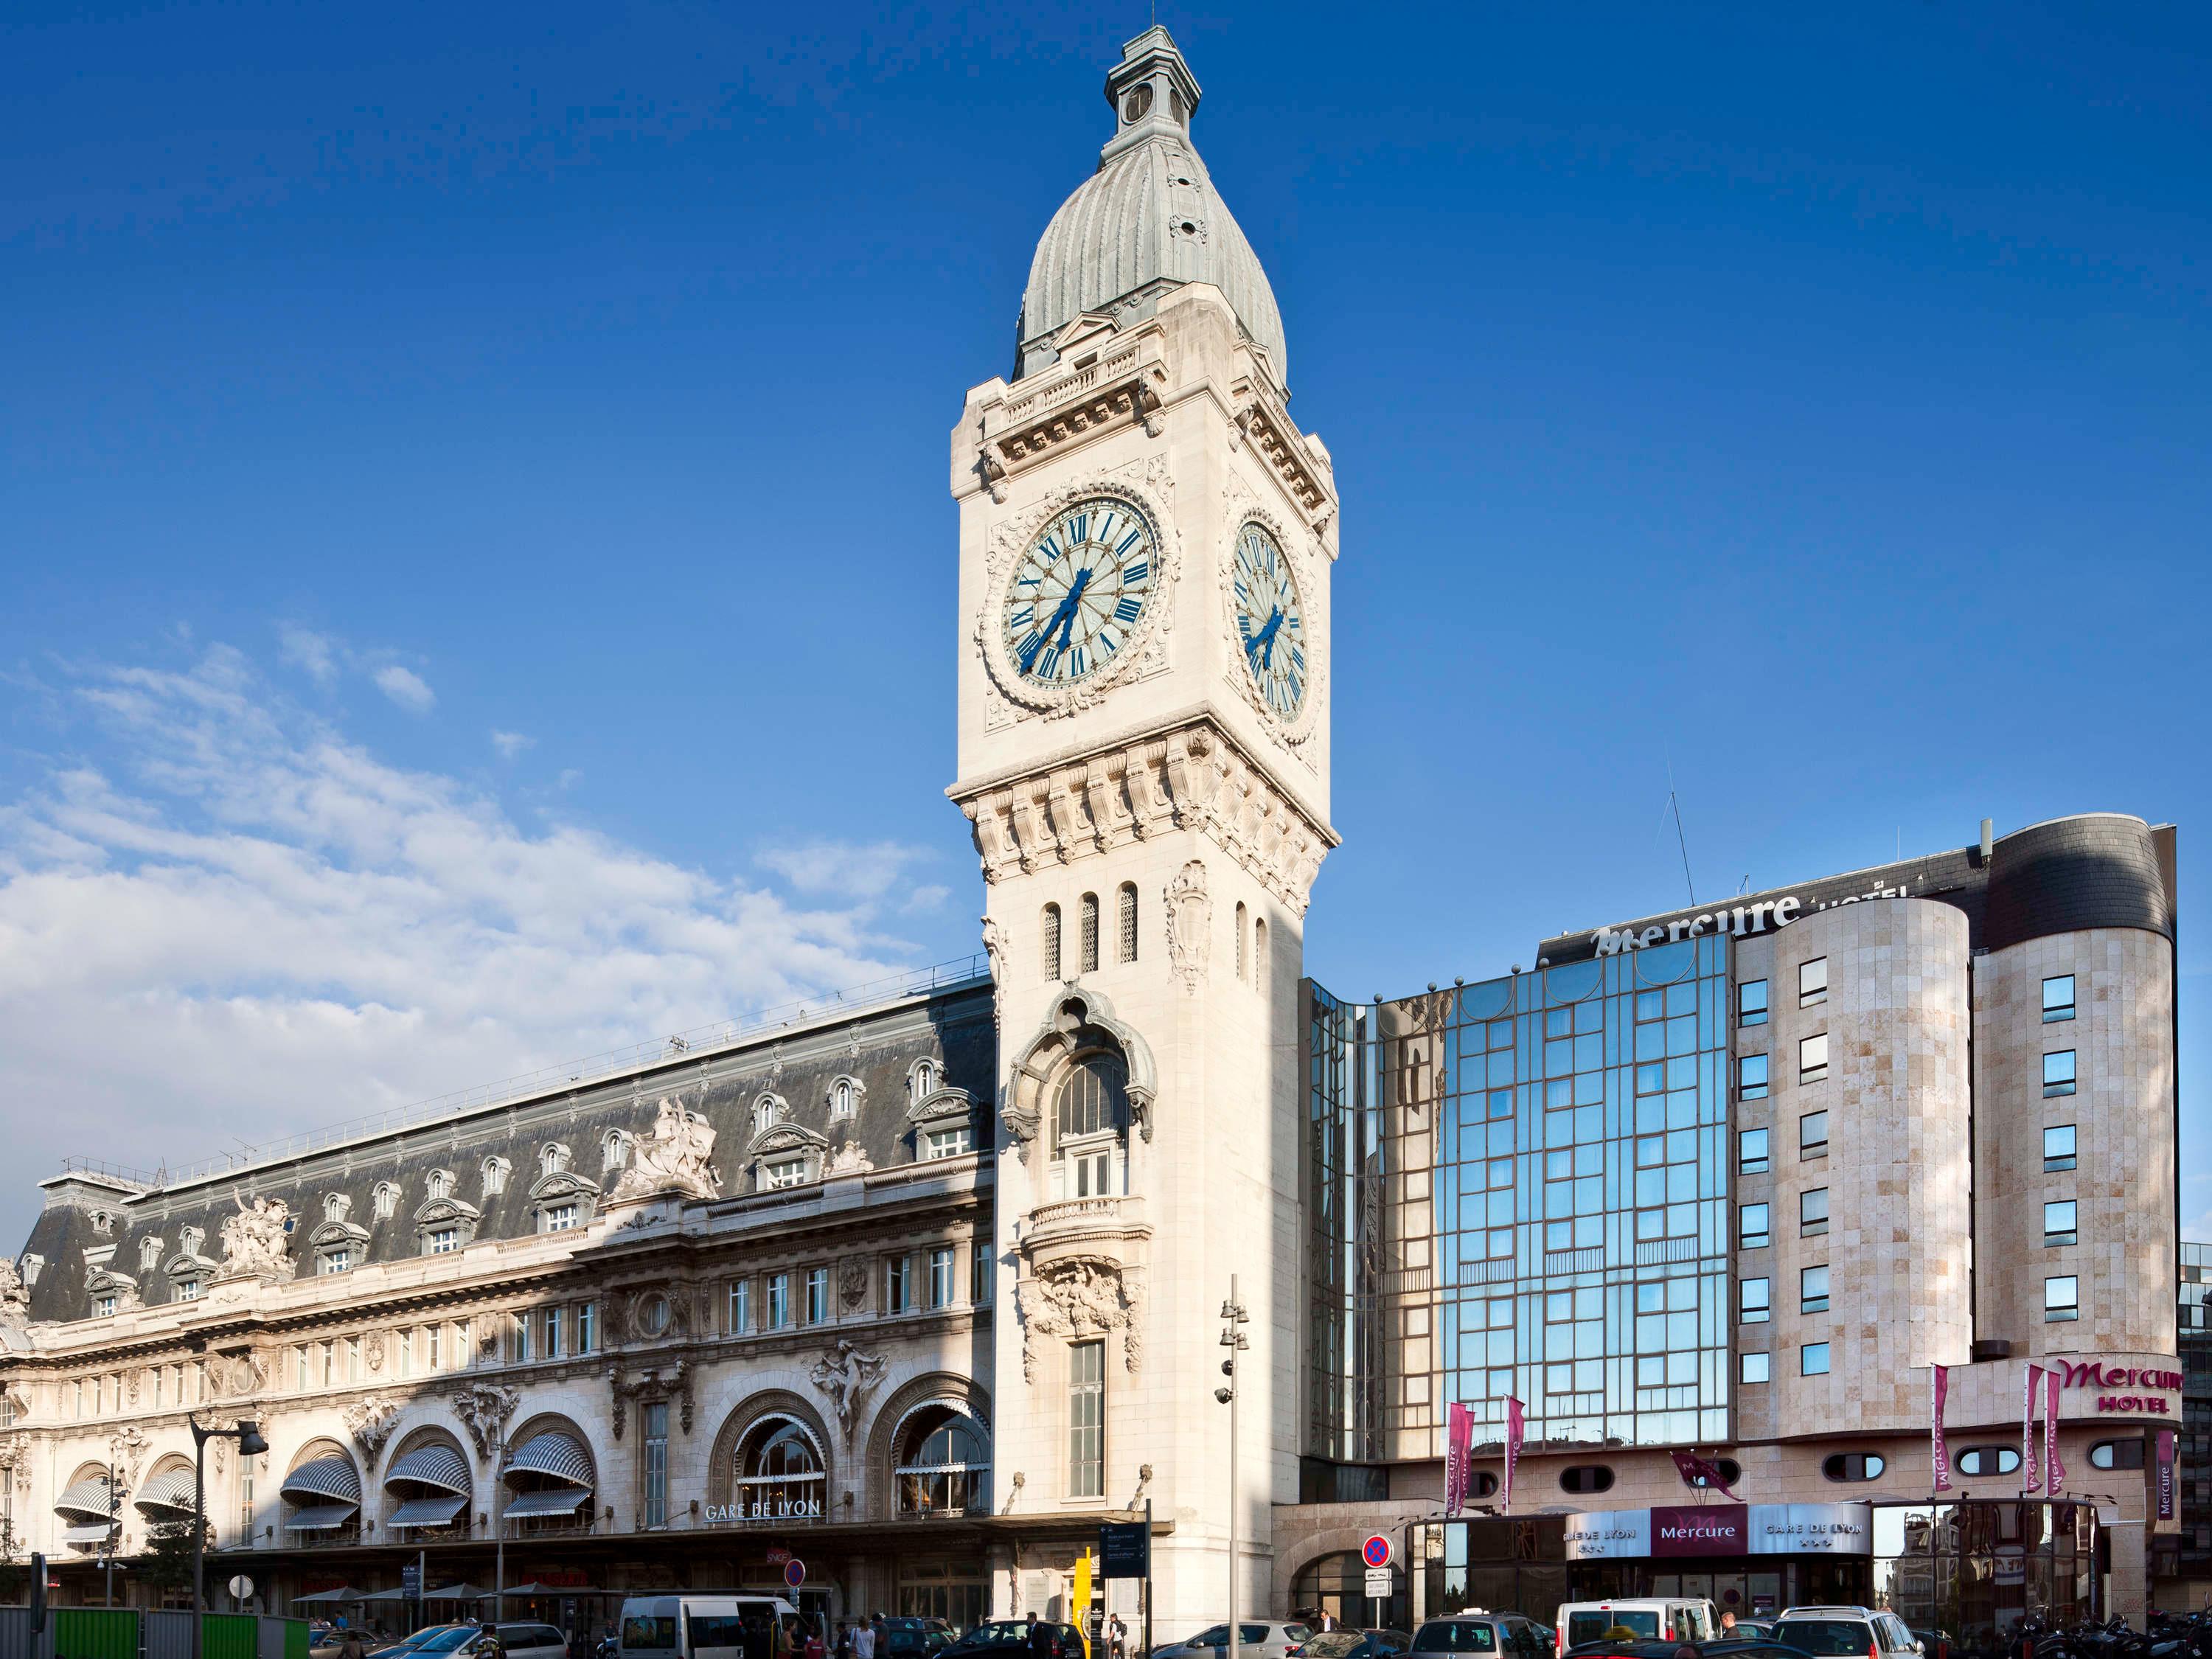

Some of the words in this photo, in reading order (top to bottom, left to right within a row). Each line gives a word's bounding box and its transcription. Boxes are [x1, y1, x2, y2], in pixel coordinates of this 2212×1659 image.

[1068, 514, 1088, 546] XII
[1099, 513, 1114, 541] I
[1038, 536, 1061, 566] XI
[1116, 529, 1141, 557] II
[1018, 574, 1041, 590] X
[1124, 561, 1148, 585] III
[1012, 606, 1033, 628] IX
[1113, 597, 1142, 624] IIII
[1099, 632, 1116, 655] V
[1071, 647, 1085, 677] VI
[2098, 1396, 2170, 1413] HOTEL
[2161, 1467, 2170, 1514] Mercure
[706, 1503, 745, 1520] GARE
[752, 1502, 771, 1517] DE
[779, 1499, 820, 1517] LYON
[1585, 1531, 1599, 1540] DE
[1604, 1529, 1636, 1540] LYON
[1661, 1526, 1735, 1538] Mercure
[1765, 1523, 1803, 1534] GARE
[1810, 1523, 1827, 1534] DE
[1832, 1523, 1863, 1534] LYON
[767, 1553, 787, 1563] SNCF
